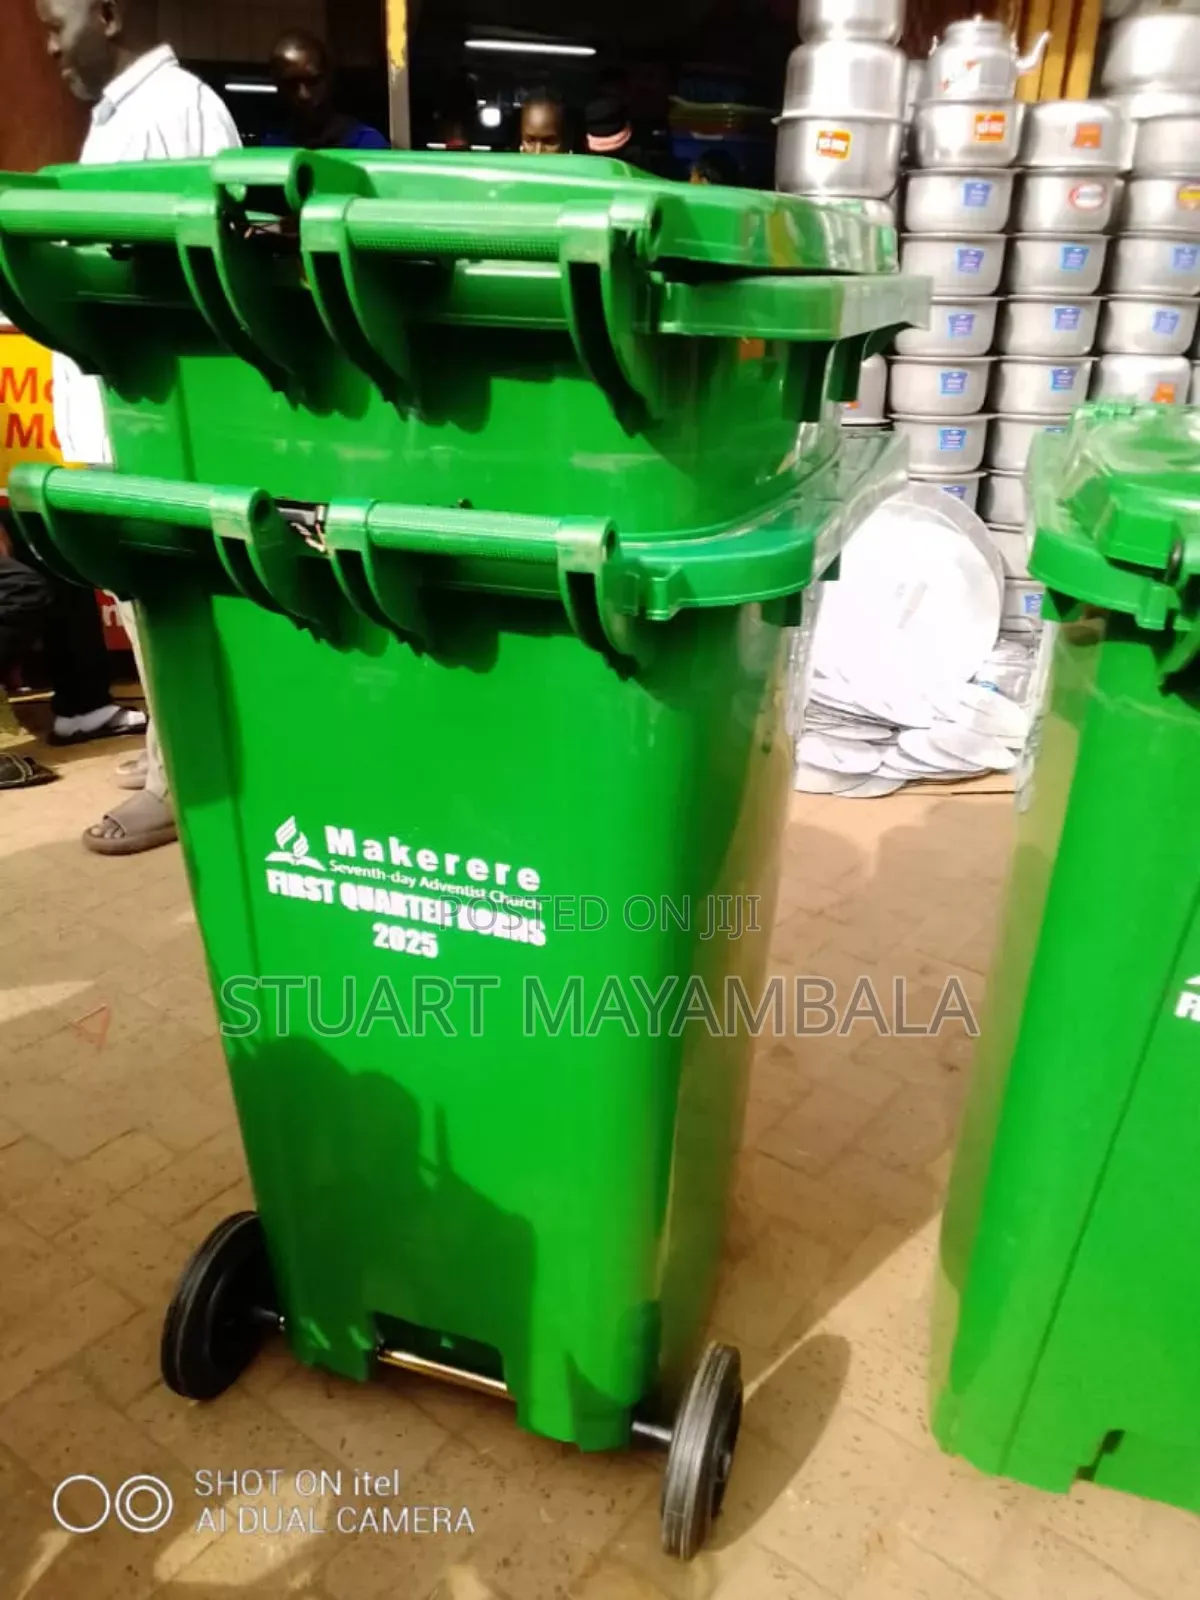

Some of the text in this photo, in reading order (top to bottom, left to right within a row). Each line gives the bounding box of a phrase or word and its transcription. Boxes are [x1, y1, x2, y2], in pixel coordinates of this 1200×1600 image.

[324, 825, 540, 892] Makerere
[329, 859, 542, 911] Seventh-day Adventist Church
[265, 868, 336, 904] FIRST
[339, 882, 453, 927] QUARTER
[372, 921, 439, 958] 2025
